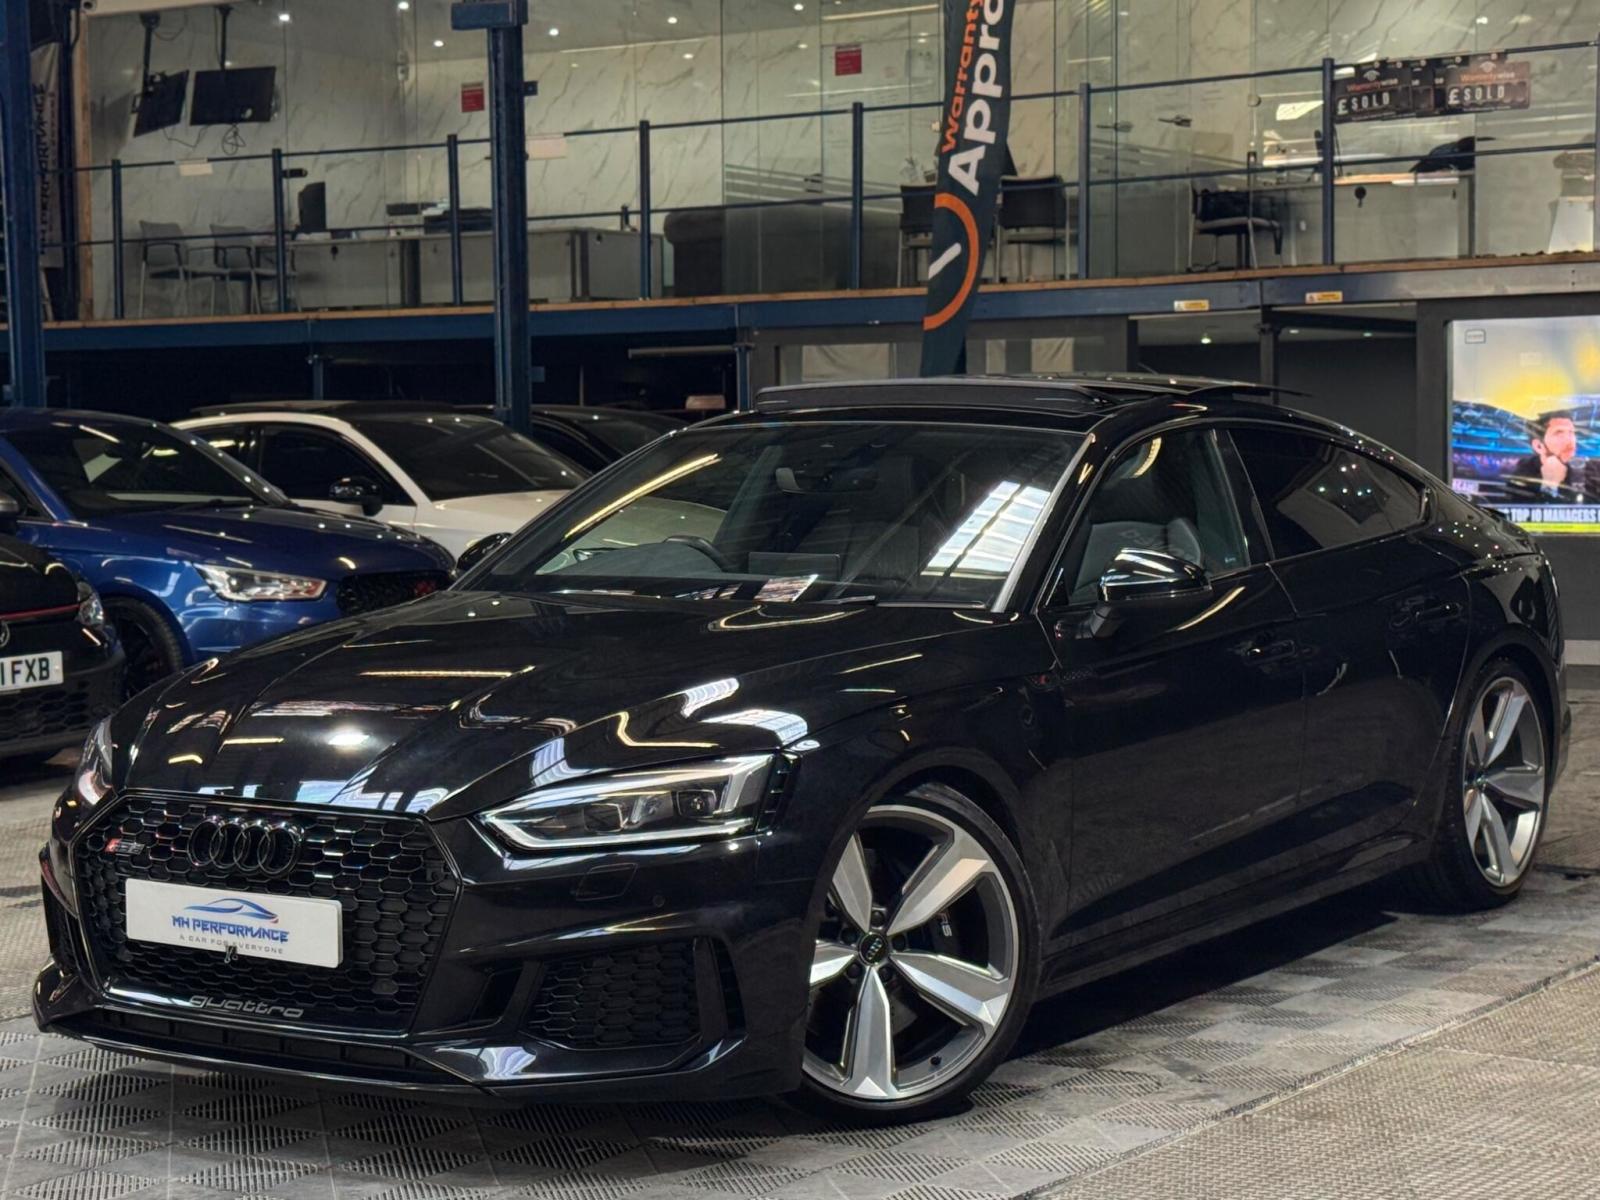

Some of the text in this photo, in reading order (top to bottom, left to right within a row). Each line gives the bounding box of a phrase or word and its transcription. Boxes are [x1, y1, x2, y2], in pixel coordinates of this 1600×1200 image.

[948, 0, 1004, 196] Appro
[1511, 508, 1531, 522] TOP
[1543, 508, 1597, 522] MANAGERS
[11, 657, 50, 685] FXB
[172, 915, 290, 944] MH PERFORMANCE
[188, 935, 208, 944] CAR
[189, 994, 305, 1019] quattro
